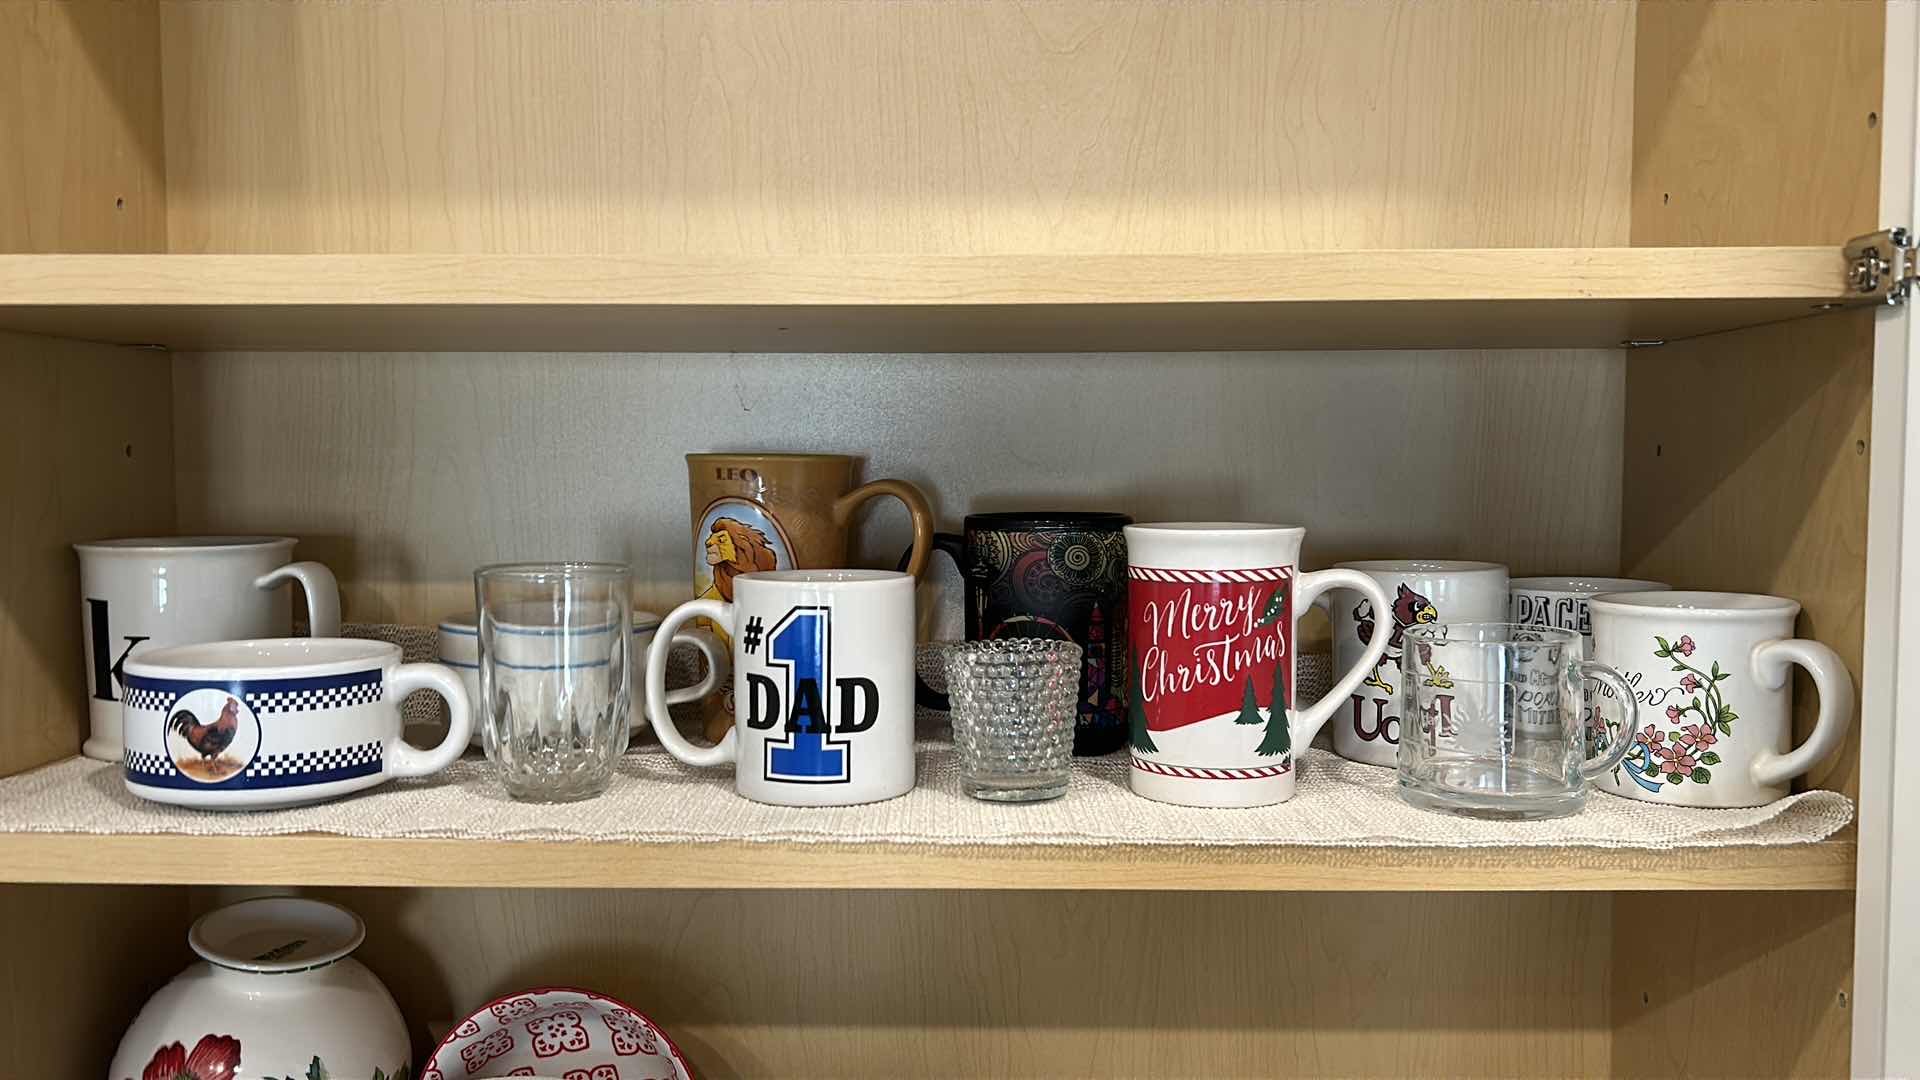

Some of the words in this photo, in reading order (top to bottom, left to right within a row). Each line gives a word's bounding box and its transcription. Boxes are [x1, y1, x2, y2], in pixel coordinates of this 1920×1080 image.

[715, 467, 758, 481] LEO
[1143, 586, 1262, 646] Merry
[1142, 620, 1286, 702] Christmas
[1593, 666, 1685, 706] Moer
[746, 672, 880, 734] DAD
